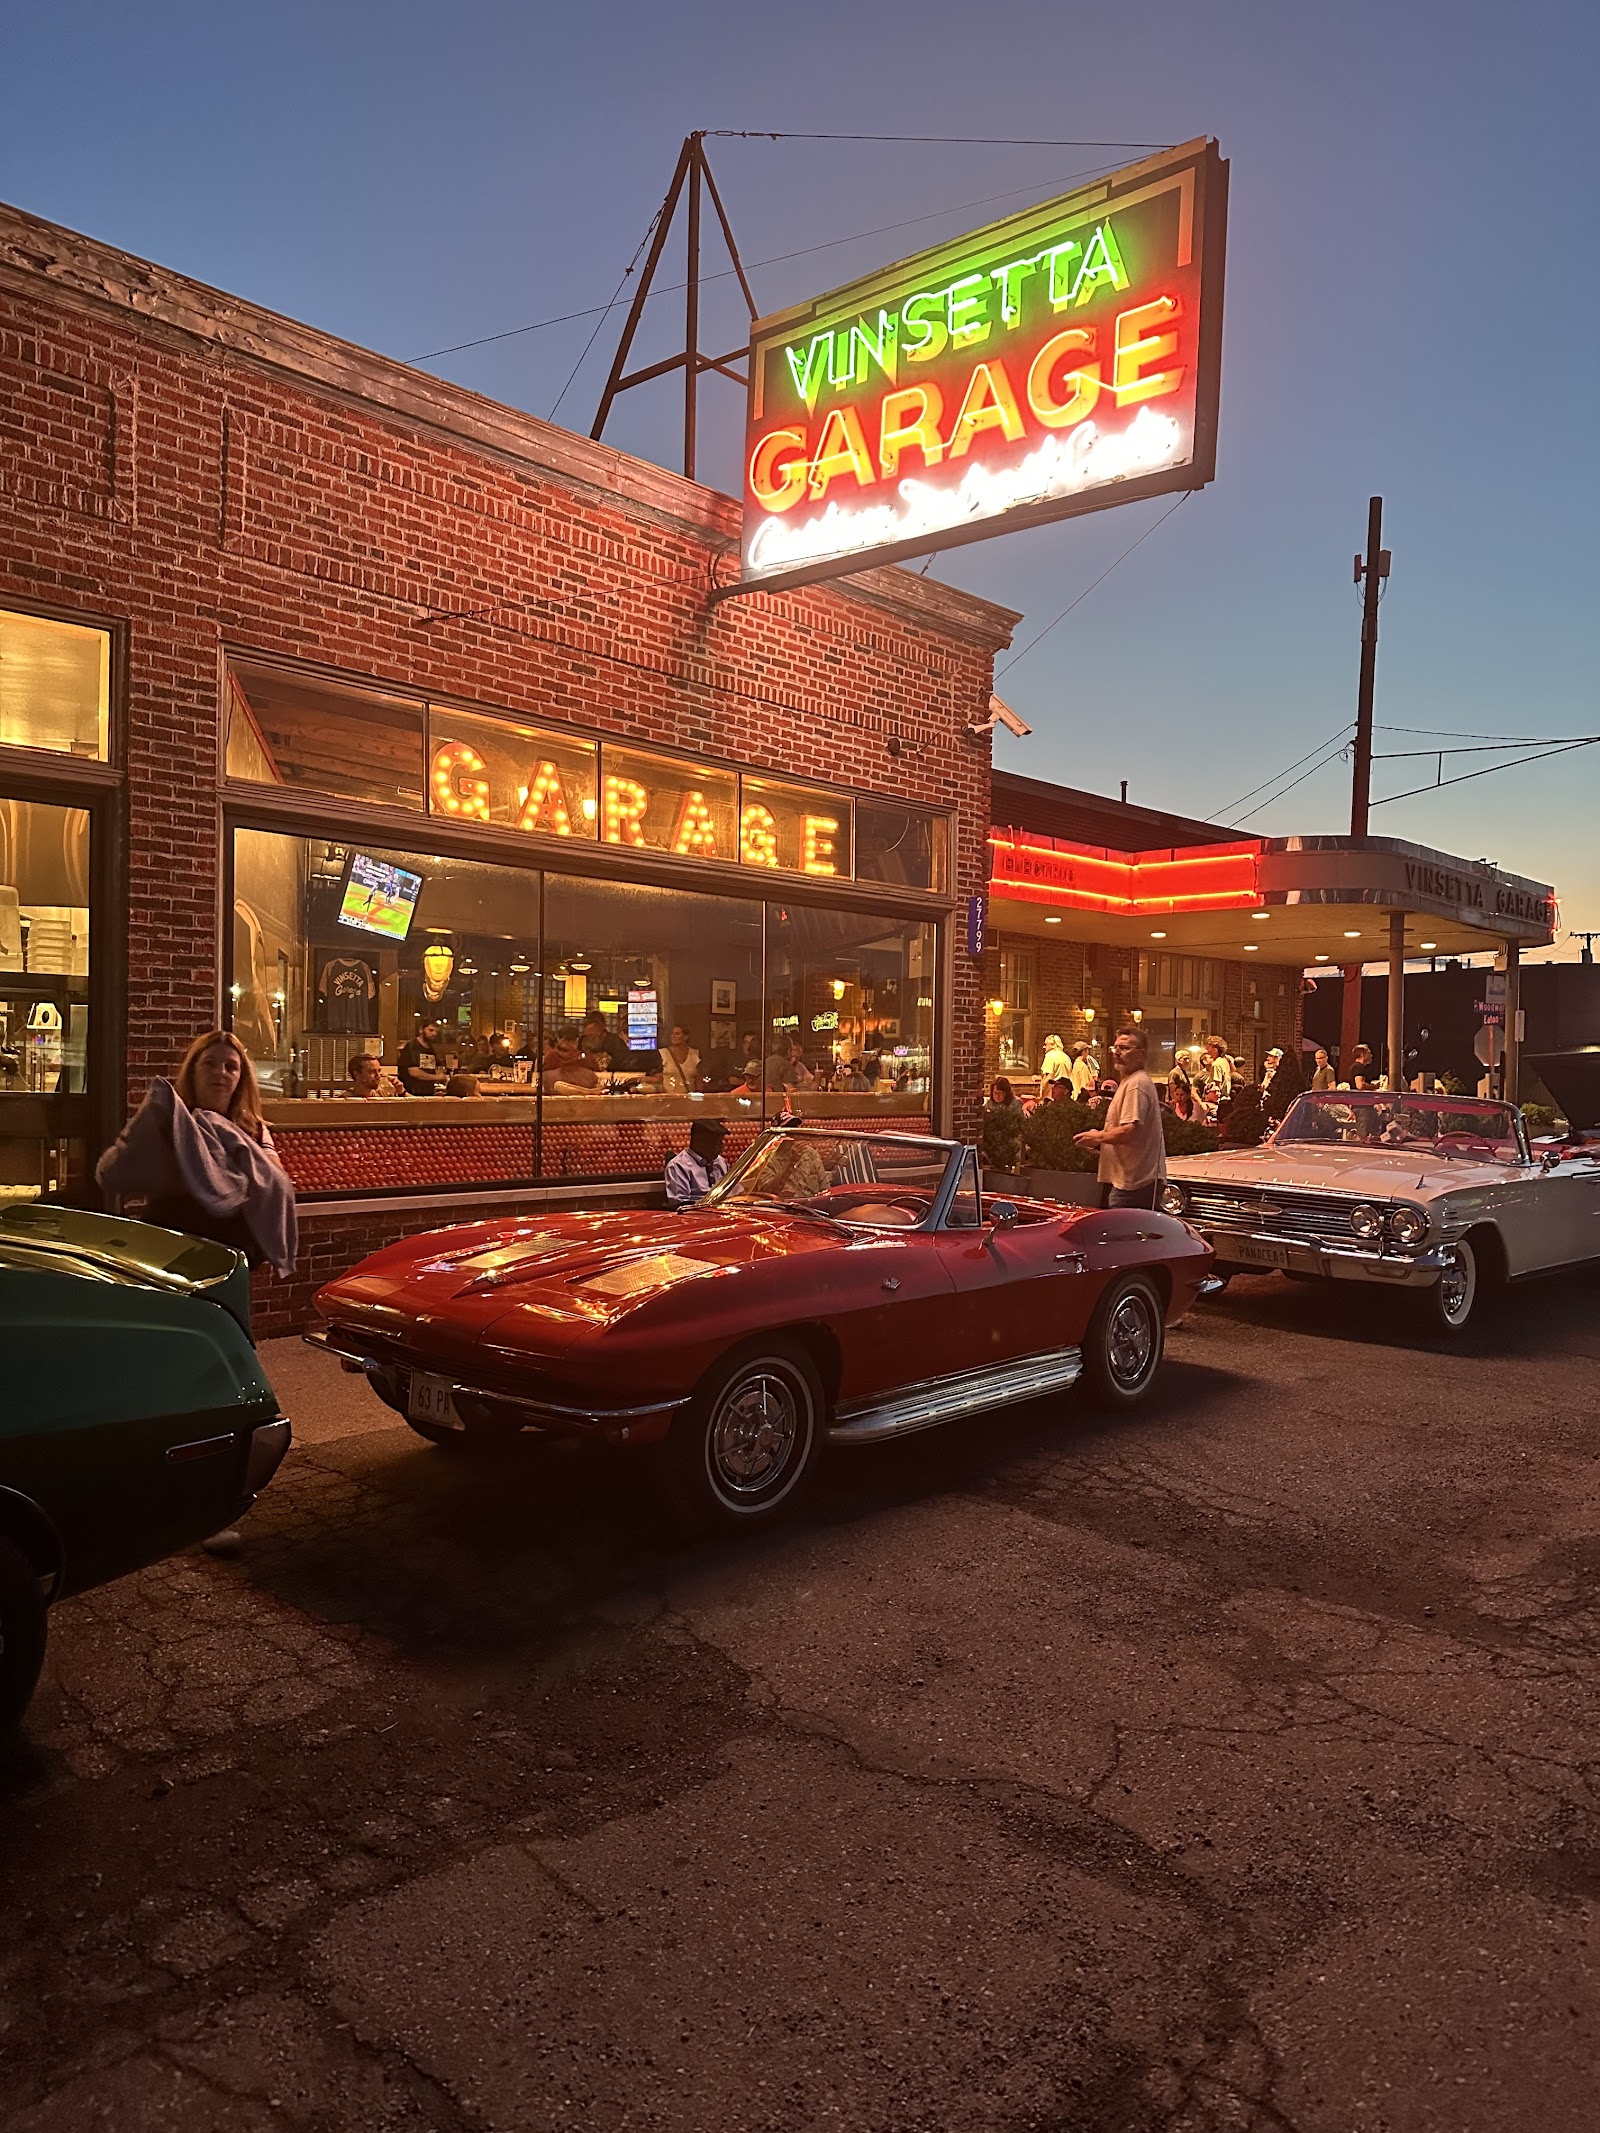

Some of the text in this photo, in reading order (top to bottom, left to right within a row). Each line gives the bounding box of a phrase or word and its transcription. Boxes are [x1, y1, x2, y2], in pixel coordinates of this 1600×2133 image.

[785, 216, 1132, 420] VINSETTA
[749, 295, 1186, 513] GARAGE
[431, 742, 838, 877] GARAGE
[1003, 854, 1076, 884] ELECTRIC
[1405, 862, 1552, 924] VINSETTA GARAGE
[975, 896, 983, 953] 27799
[333, 971, 364, 988] VINSETTA
[335, 985, 362, 999] Garage
[1483, 1014, 1499, 1025] Eaton
[1239, 1246, 1279, 1263] PANACEA
[418, 1385, 431, 1410] 63
